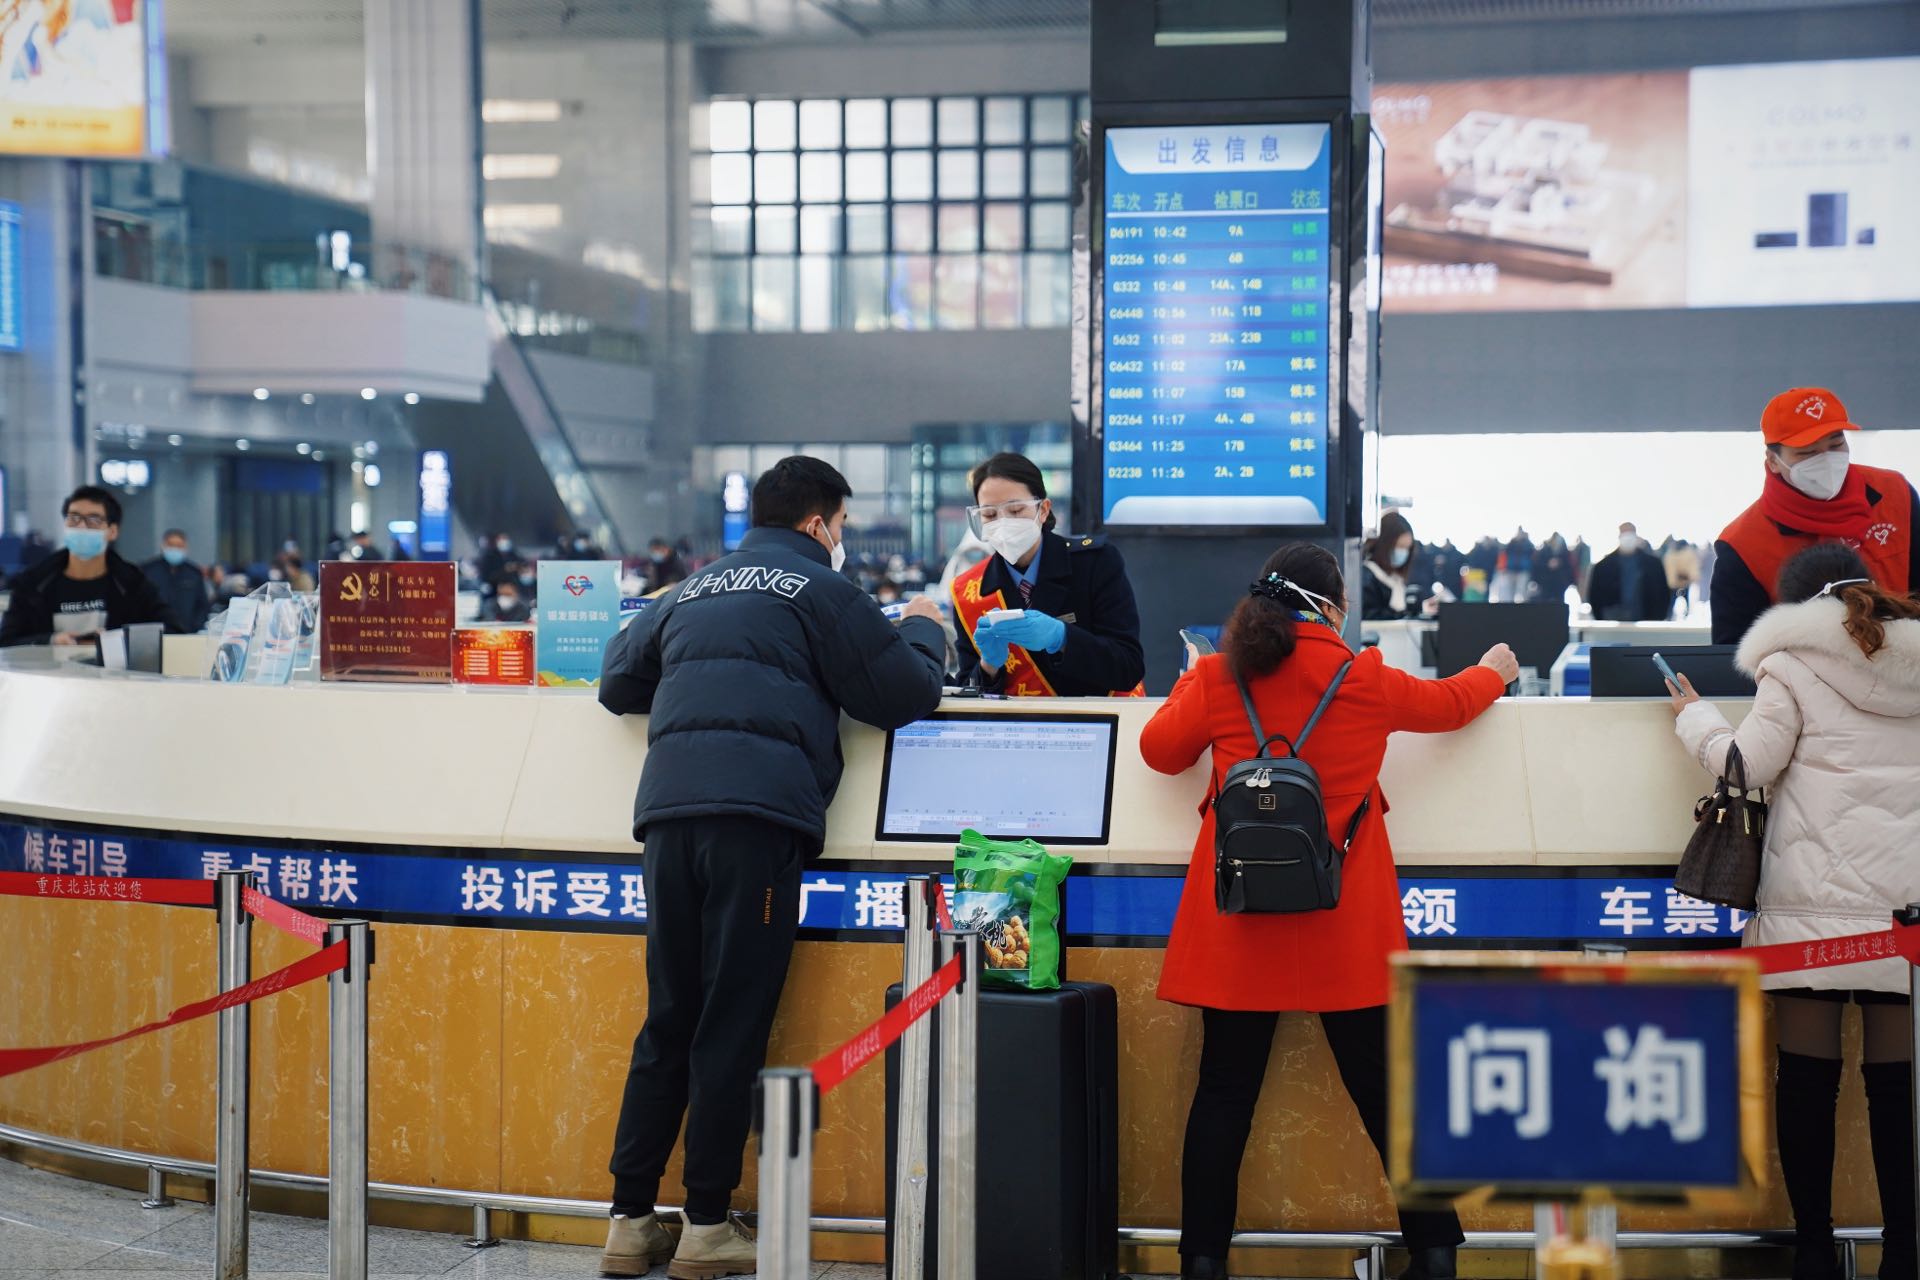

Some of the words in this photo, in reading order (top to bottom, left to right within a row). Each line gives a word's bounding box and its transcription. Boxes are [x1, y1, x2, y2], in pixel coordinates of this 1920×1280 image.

[1158, 135, 1279, 164] 出发信息
[1112, 192, 1141, 210] 车次
[1154, 192, 1184, 210] 开点
[1214, 190, 1258, 209] 检票口
[1291, 188, 1321, 208] 状态
[1153, 226, 1186, 238] 10:42
[1228, 225, 1243, 237] 9A
[1110, 254, 1144, 266] D2256
[1153, 253, 1186, 265] 10:45
[1113, 334, 1140, 345] 5632
[1152, 360, 1185, 372] 11:02
[1225, 360, 1246, 371] 17A
[1152, 387, 1185, 398] 11:07
[1152, 414, 1185, 425] 11:17
[1152, 441, 1185, 452] 11:25
[1224, 440, 1245, 451] 17B
[1152, 467, 1185, 478] 11:26
[677, 566, 810, 603] LI-NING
[23, 830, 128, 878] 候车引导
[35, 876, 143, 900] 重庆北站欢迎您
[1599, 886, 1748, 935] 车票
[1802, 938, 1896, 967] 重庆北站欢迎您
[1447, 1022, 1707, 1146] 问询
